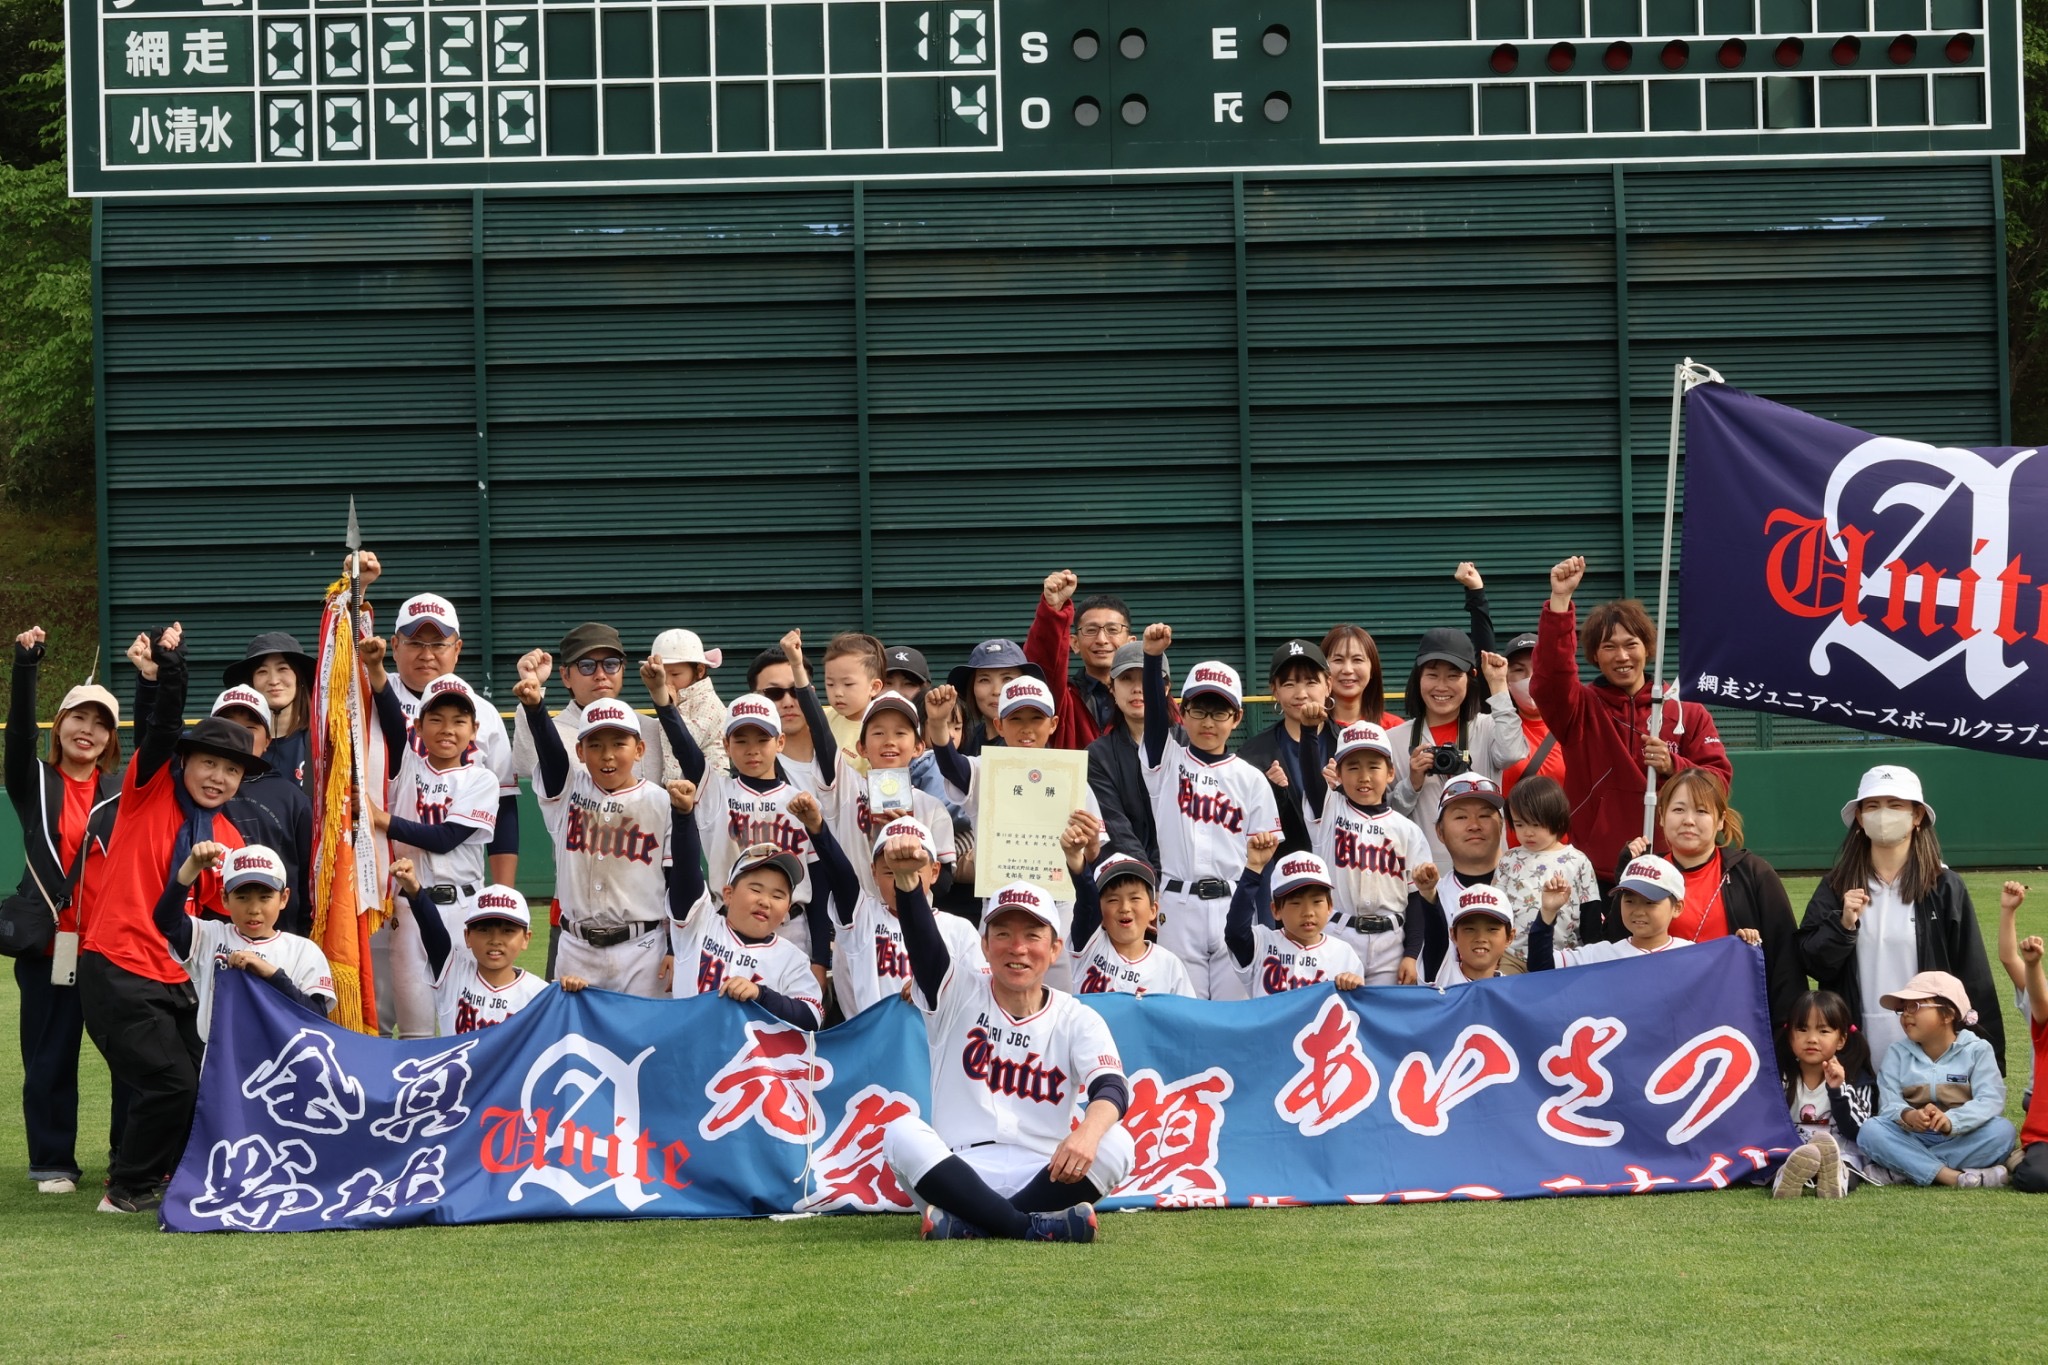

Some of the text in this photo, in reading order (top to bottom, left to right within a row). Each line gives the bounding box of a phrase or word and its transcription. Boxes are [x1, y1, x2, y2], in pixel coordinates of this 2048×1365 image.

[1020, 32, 1048, 63] S
[1212, 27, 1237, 60] E
[125, 30, 229, 77] 網走
[951, 84, 987, 135] 4
[1020, 97, 1050, 129] O
[129, 107, 233, 154] 小清水
[408, 602, 446, 617] Unite
[1289, 641, 1304, 656] LA
[1195, 668, 1233, 687] Unite
[430, 680, 468, 694] Unite
[1006, 684, 1043, 700] Unite
[223, 690, 260, 706] Unite
[587, 706, 625, 723] Unite
[731, 702, 770, 717] Unite
[1343, 727, 1380, 744] Unite
[432, 783, 449, 794] JBC
[1013, 784, 1056, 798] 優勝
[603, 802, 625, 814] JBC
[758, 802, 776, 812] JBC
[565, 803, 660, 867] Unite
[1367, 825, 1384, 836] JBC
[234, 855, 275, 872] Unite
[1281, 859, 1322, 877] Unite
[1626, 862, 1662, 880] Unite
[478, 893, 518, 910] Unite
[998, 888, 1040, 907] Unite
[1459, 891, 1498, 909] Unite
[736, 954, 758, 969] JBC
[1299, 957, 1318, 968] JBC
[1121, 970, 1141, 984] JBC
[490, 998, 508, 1010] JBC
[1007, 1031, 1031, 1049] JBC
[963, 1027, 1068, 1106] Unite
[1070, 1066, 1234, 1198] 顔
[480, 1104, 694, 1190] Unite
